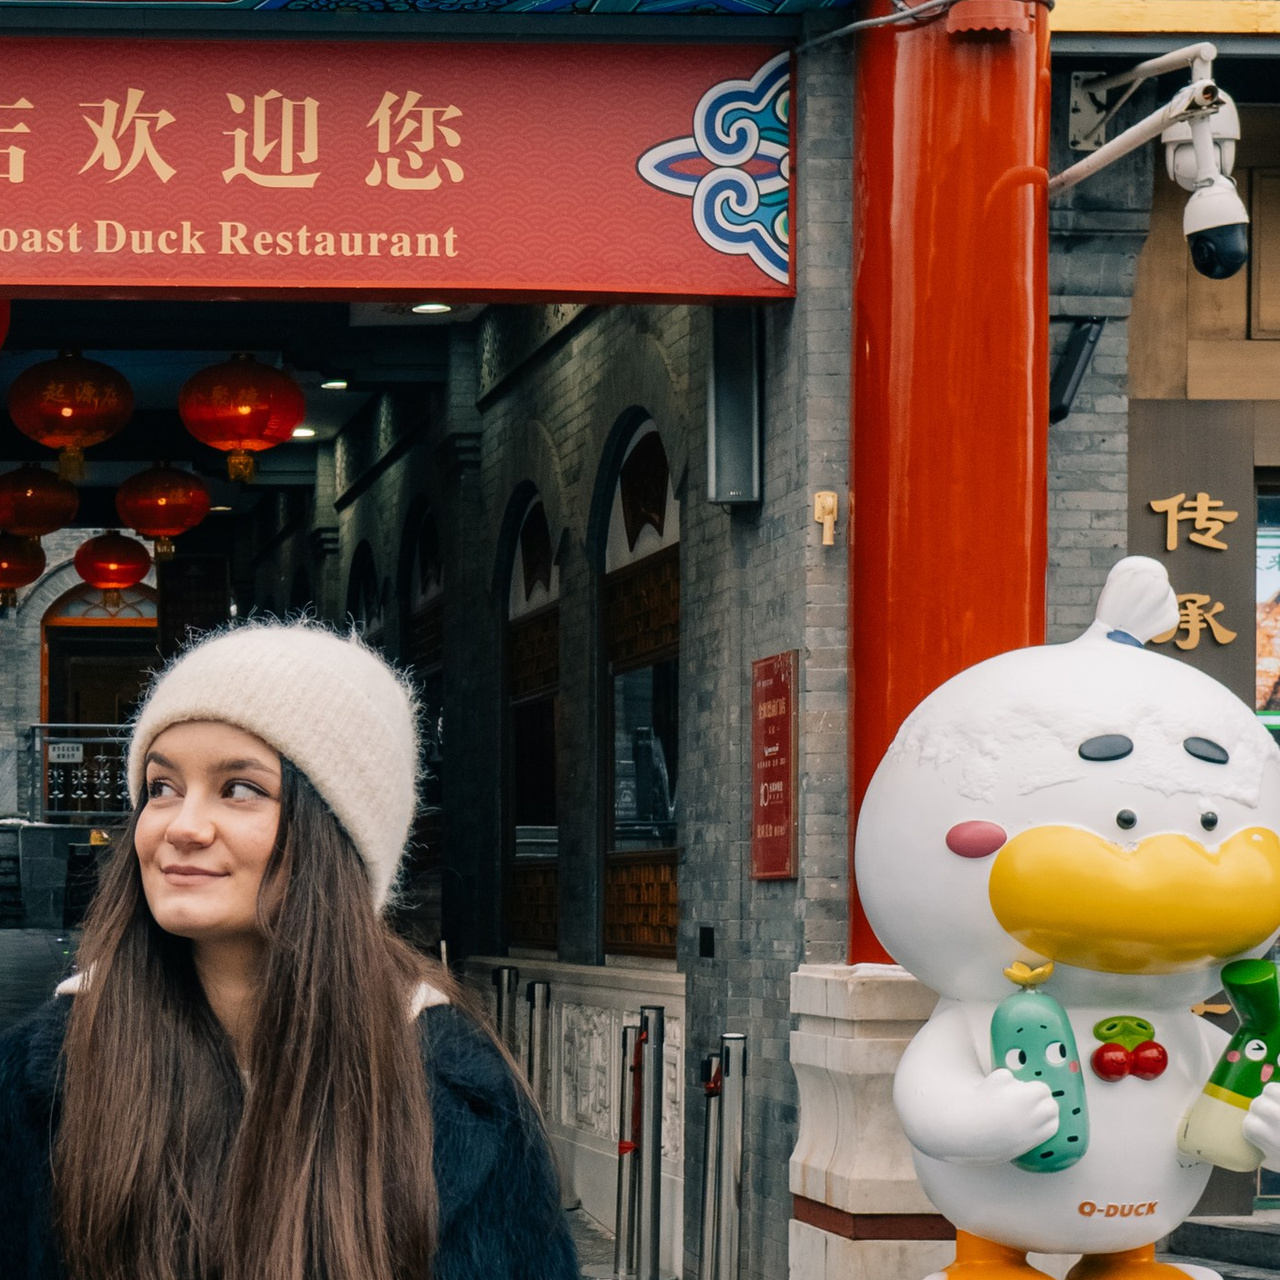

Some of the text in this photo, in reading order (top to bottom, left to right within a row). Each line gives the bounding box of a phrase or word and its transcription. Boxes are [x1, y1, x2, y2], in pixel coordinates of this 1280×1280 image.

[94, 220, 207, 255] Duck
[218, 221, 459, 258] Restaurant
[1150, 492, 1239, 650] 传承
[1077, 1200, 1159, 1218] Q-DUCK
